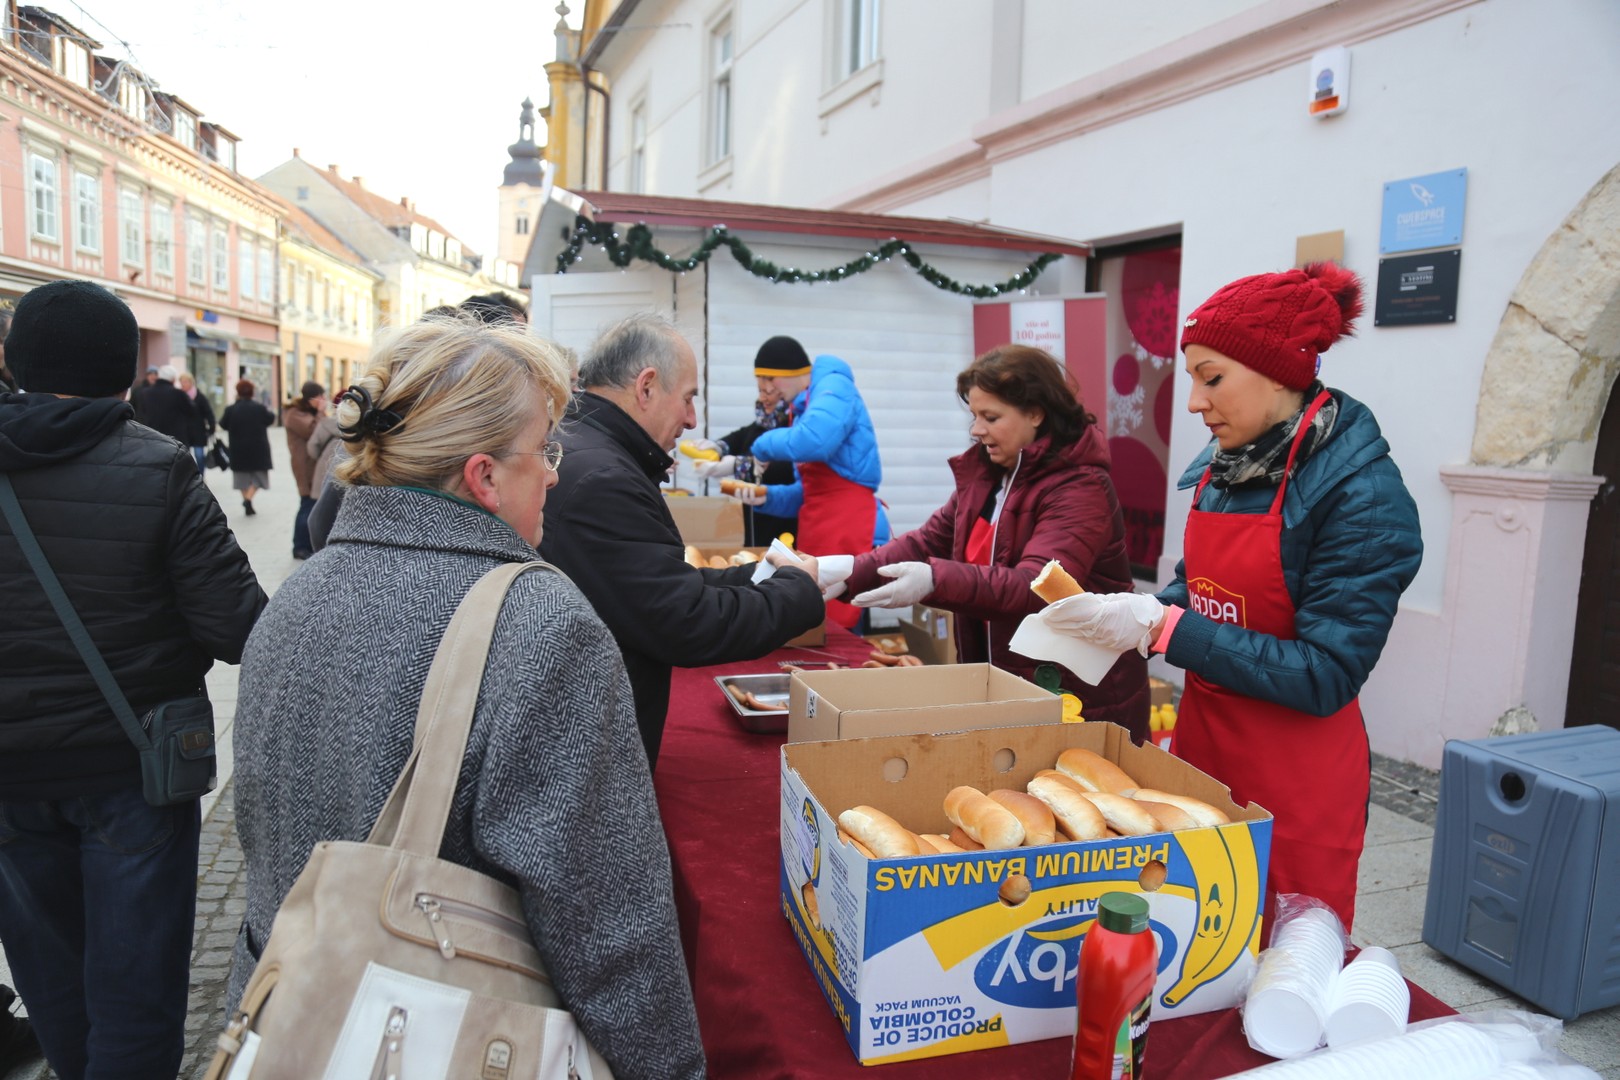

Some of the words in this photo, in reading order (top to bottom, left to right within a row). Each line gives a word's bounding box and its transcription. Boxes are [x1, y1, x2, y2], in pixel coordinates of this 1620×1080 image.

[1016, 328, 1033, 339] 100
[1035, 330, 1061, 341] godina
[1035, 842, 1169, 878] PREMIUM
[875, 857, 1026, 891] BANANAS
[1043, 898, 1099, 917] ALITY
[875, 1001, 908, 1013] PACK
[911, 995, 961, 1010] VACUUM
[869, 1006, 976, 1030] COLOMBIA
[872, 1030, 901, 1047] OF
[907, 1017, 1002, 1043] PRODUCE
